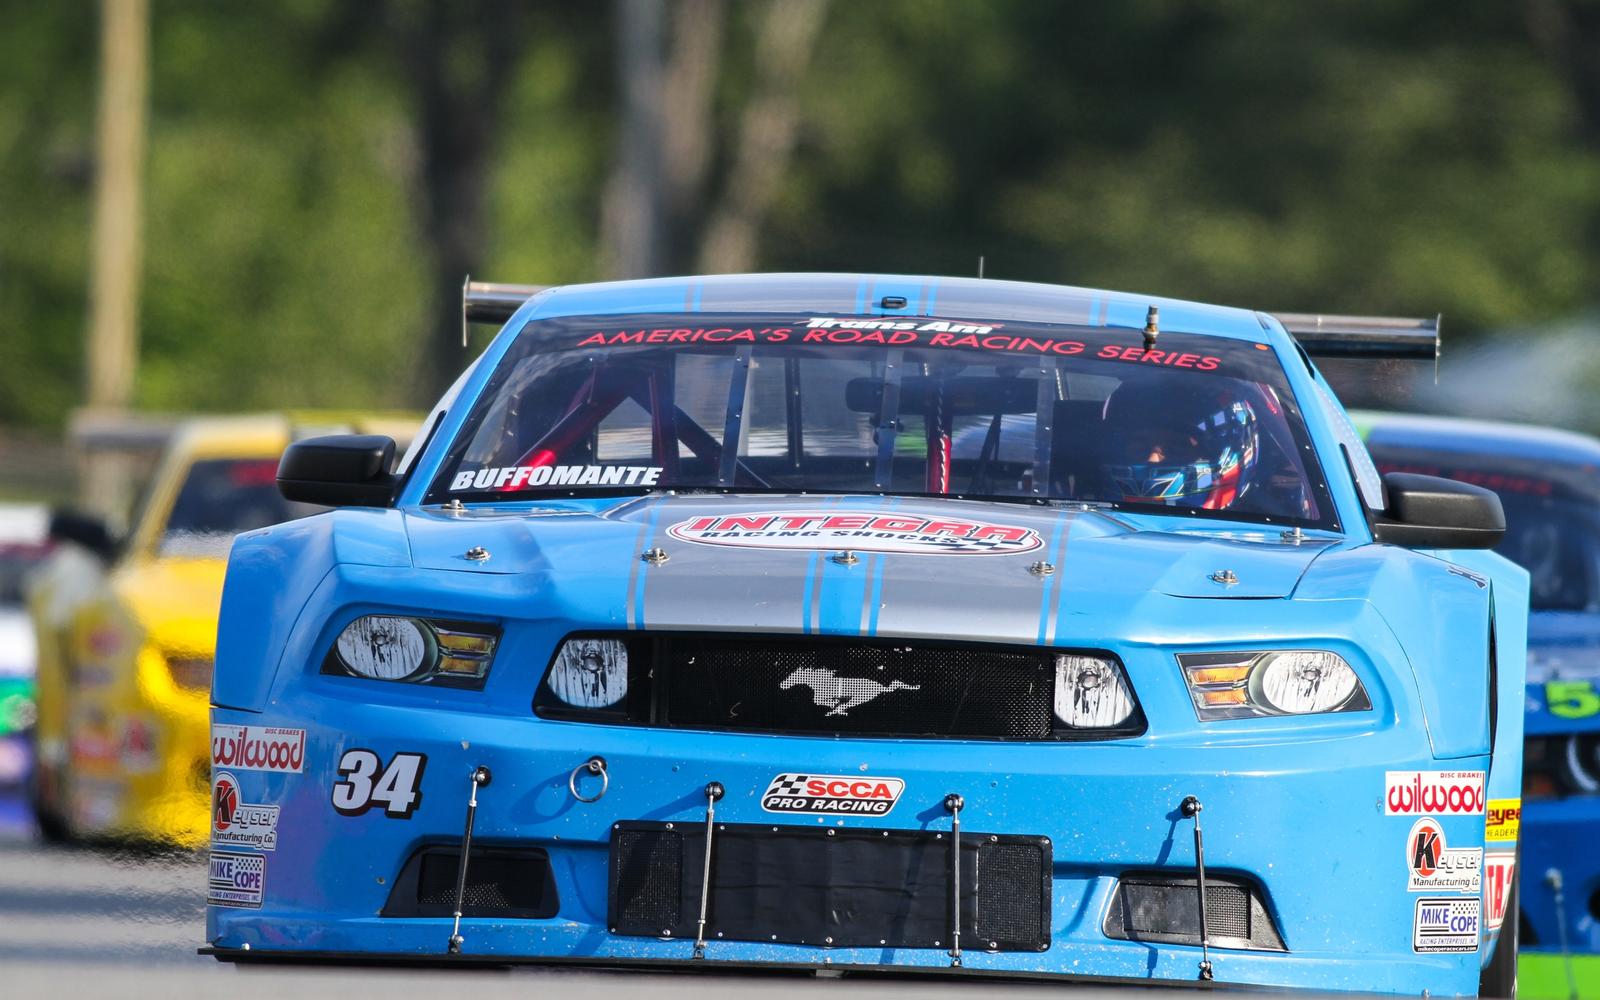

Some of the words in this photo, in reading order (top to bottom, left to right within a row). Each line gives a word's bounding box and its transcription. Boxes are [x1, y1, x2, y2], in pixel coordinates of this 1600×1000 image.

[806, 317, 914, 331] Trans
[916, 321, 992, 334] Am
[576, 328, 793, 347] AMERICA'S
[803, 328, 918, 345] ROAD
[929, 332, 1086, 355] RACING
[1097, 344, 1222, 370] SERIES
[449, 465, 664, 491] BUFFOMANTE
[686, 515, 1029, 542] INTEGRA
[700, 530, 821, 538] RACING
[830, 530, 959, 544] SHOCKS
[213, 727, 305, 770] wilwood
[331, 748, 426, 820] 34
[807, 780, 893, 799] SCCA
[1388, 772, 1485, 813] wilwood
[213, 786, 277, 829] Keyser
[766, 798, 807, 809] PRO
[811, 799, 888, 812] RACING
[1486, 807, 1520, 827] eyea
[234, 870, 261, 889] COPE
[1413, 877, 1470, 888] Manufacturing
[1421, 908, 1450, 924] MIKE
[1450, 915, 1477, 932] COPE
